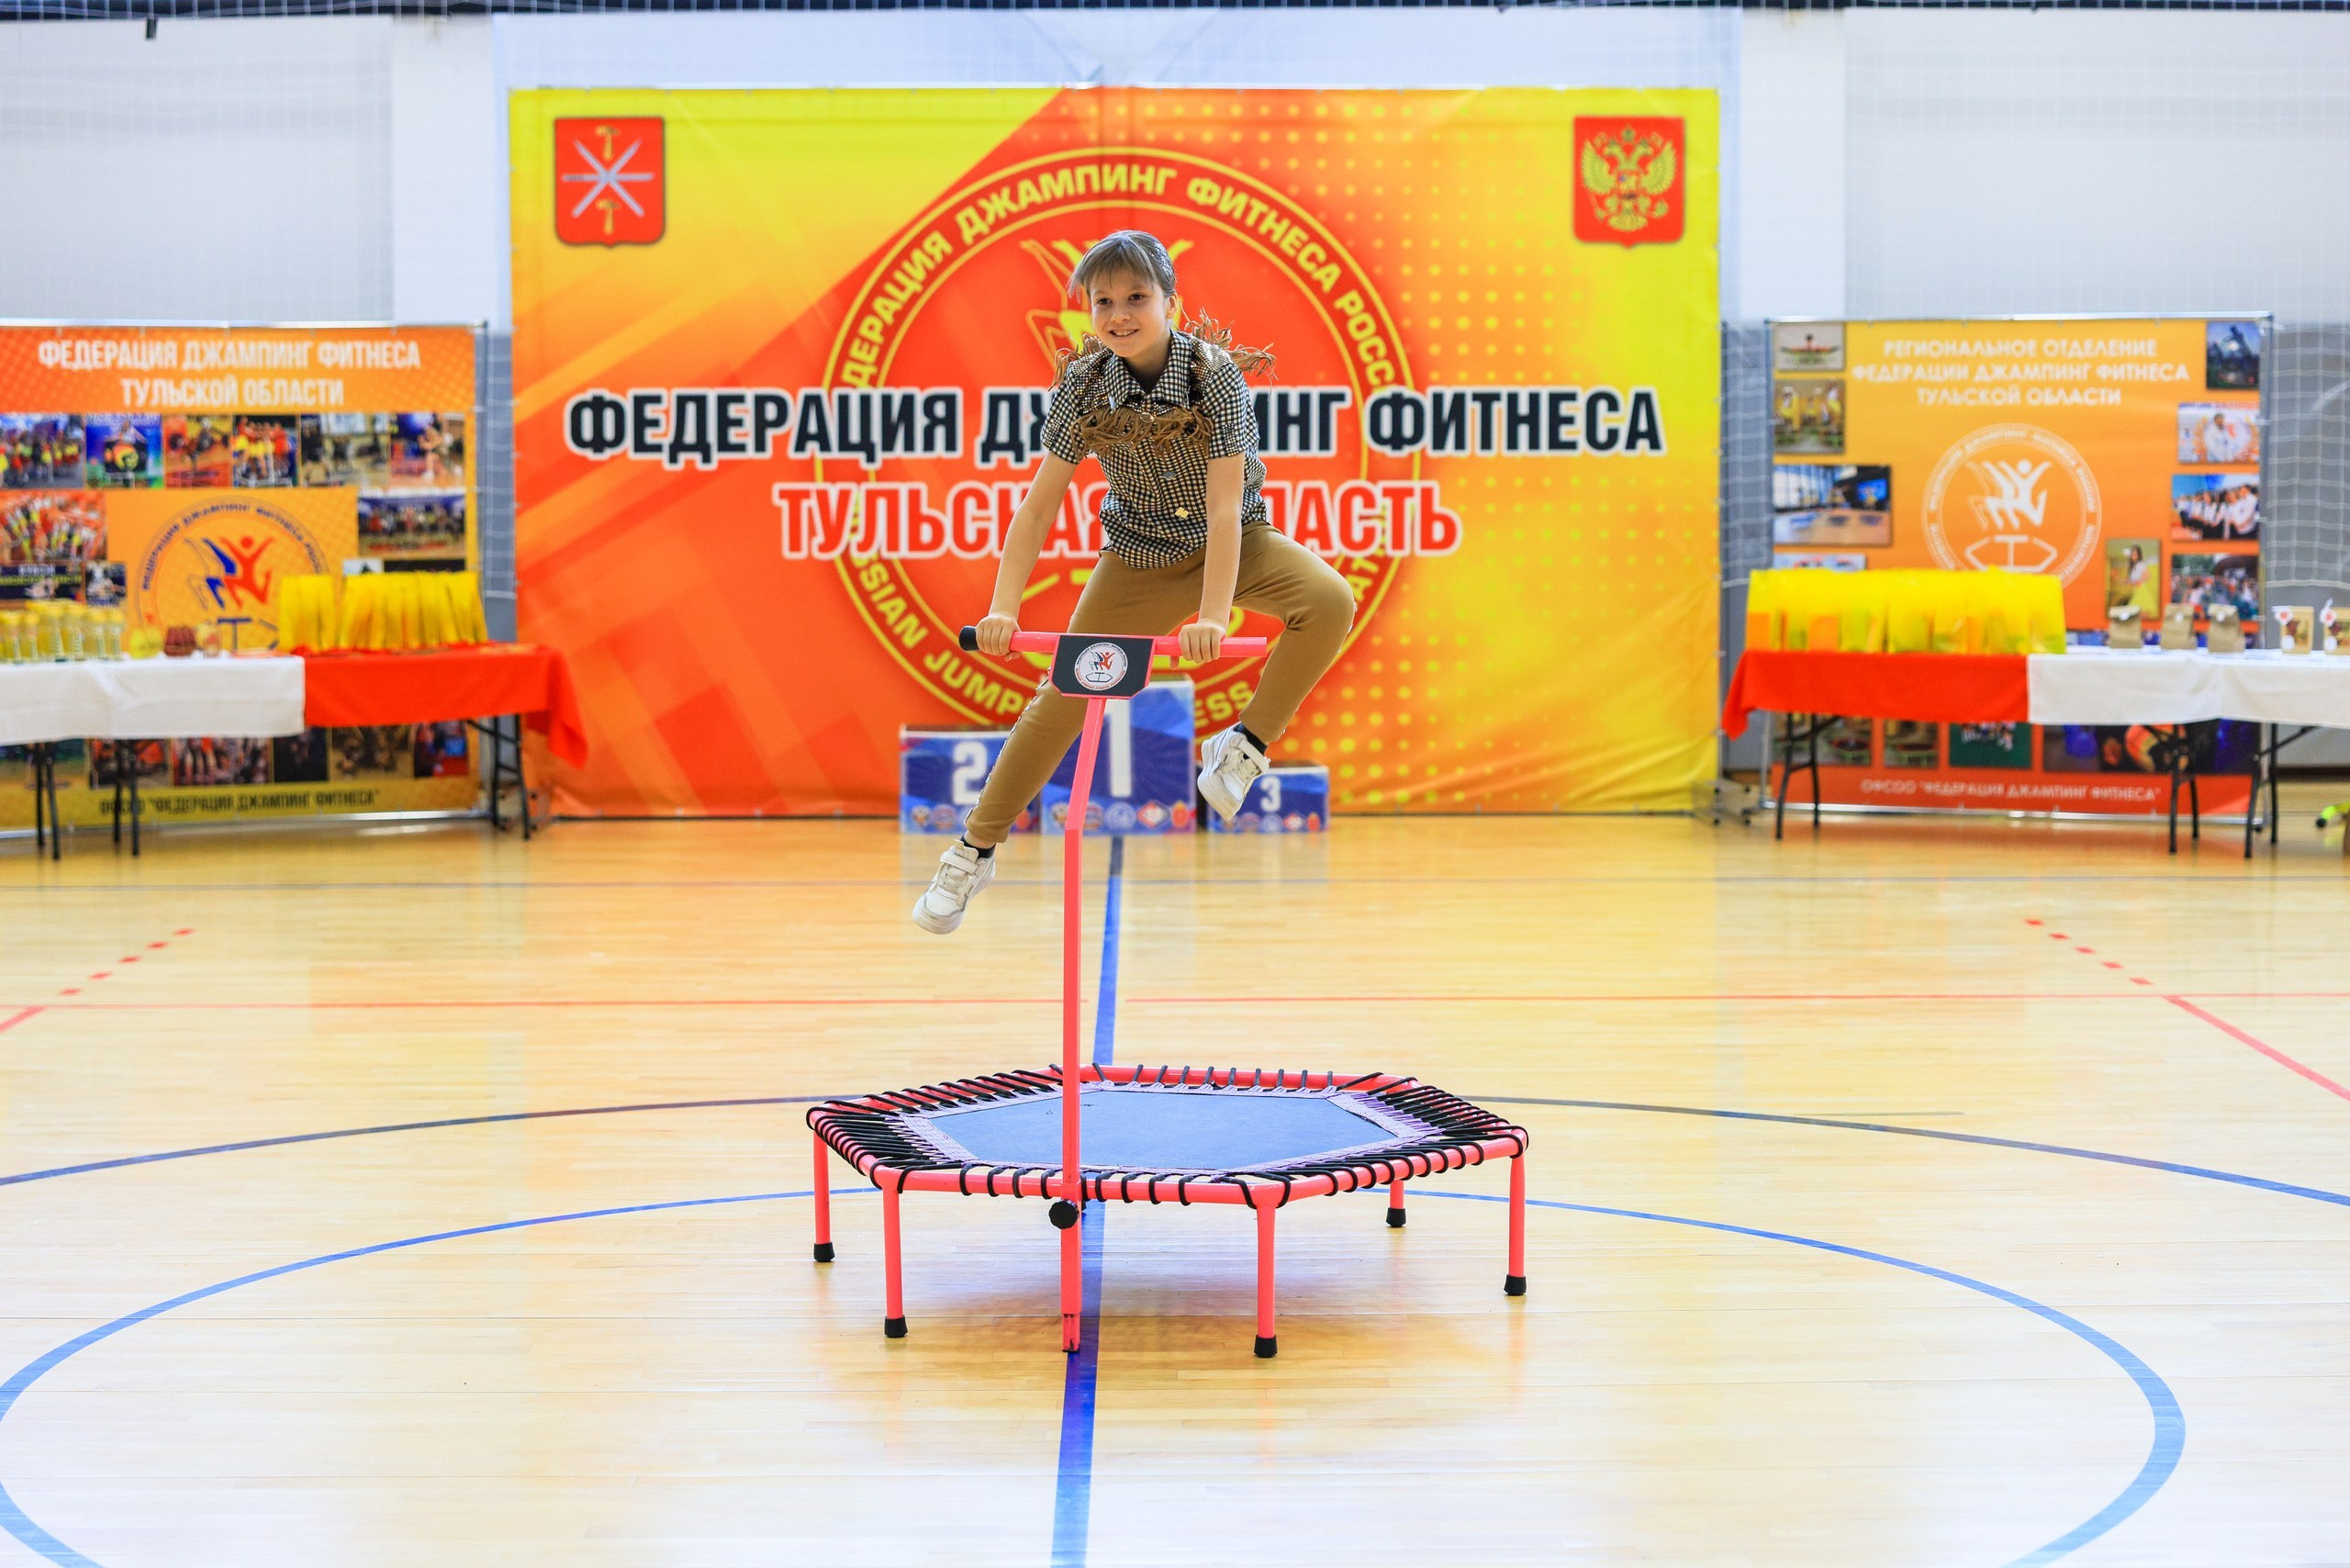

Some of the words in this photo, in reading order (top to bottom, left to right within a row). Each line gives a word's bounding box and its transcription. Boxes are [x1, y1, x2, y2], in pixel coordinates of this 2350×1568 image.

[840, 230, 953, 389] ДЕРАЦИЯ
[955, 163, 1178, 245] ДЖАМПИНГ
[1186, 175, 1342, 294] ФИТНЕСА
[1334, 288, 1396, 390] РОСС
[39, 340, 178, 370] ФЕДЕРАЦИЯ
[182, 340, 314, 370] ДЖАМПИНГ
[317, 340, 421, 369] ФИТНЕСА
[1884, 339, 2037, 358] РЕГИОНАЛЬНОЕ
[2042, 338, 2157, 360] ОТДЕЛЕНИЕ
[1973, 364, 2092, 383] ДЖАМПИНГ
[2096, 363, 2189, 383] ФИТНЕСА
[121, 375, 239, 407] ТУЛЬСКОЙ
[242, 378, 344, 407] ОБЛАСТИ
[1917, 386, 2020, 407] ТУЛЬСКОЙ
[2025, 386, 2121, 407] ОБЛАСТИ
[566, 389, 960, 466] ФЕДЕРАЦИЯ
[1367, 389, 1663, 454] ФИТНЕСА
[1259, 484, 1460, 555] АСТЬ
[849, 553, 929, 649] SIAN
[923, 650, 1024, 716] JUMP
[1104, 699, 1131, 797] 1
[951, 741, 988, 805] 2
[1259, 777, 1282, 812] 3
